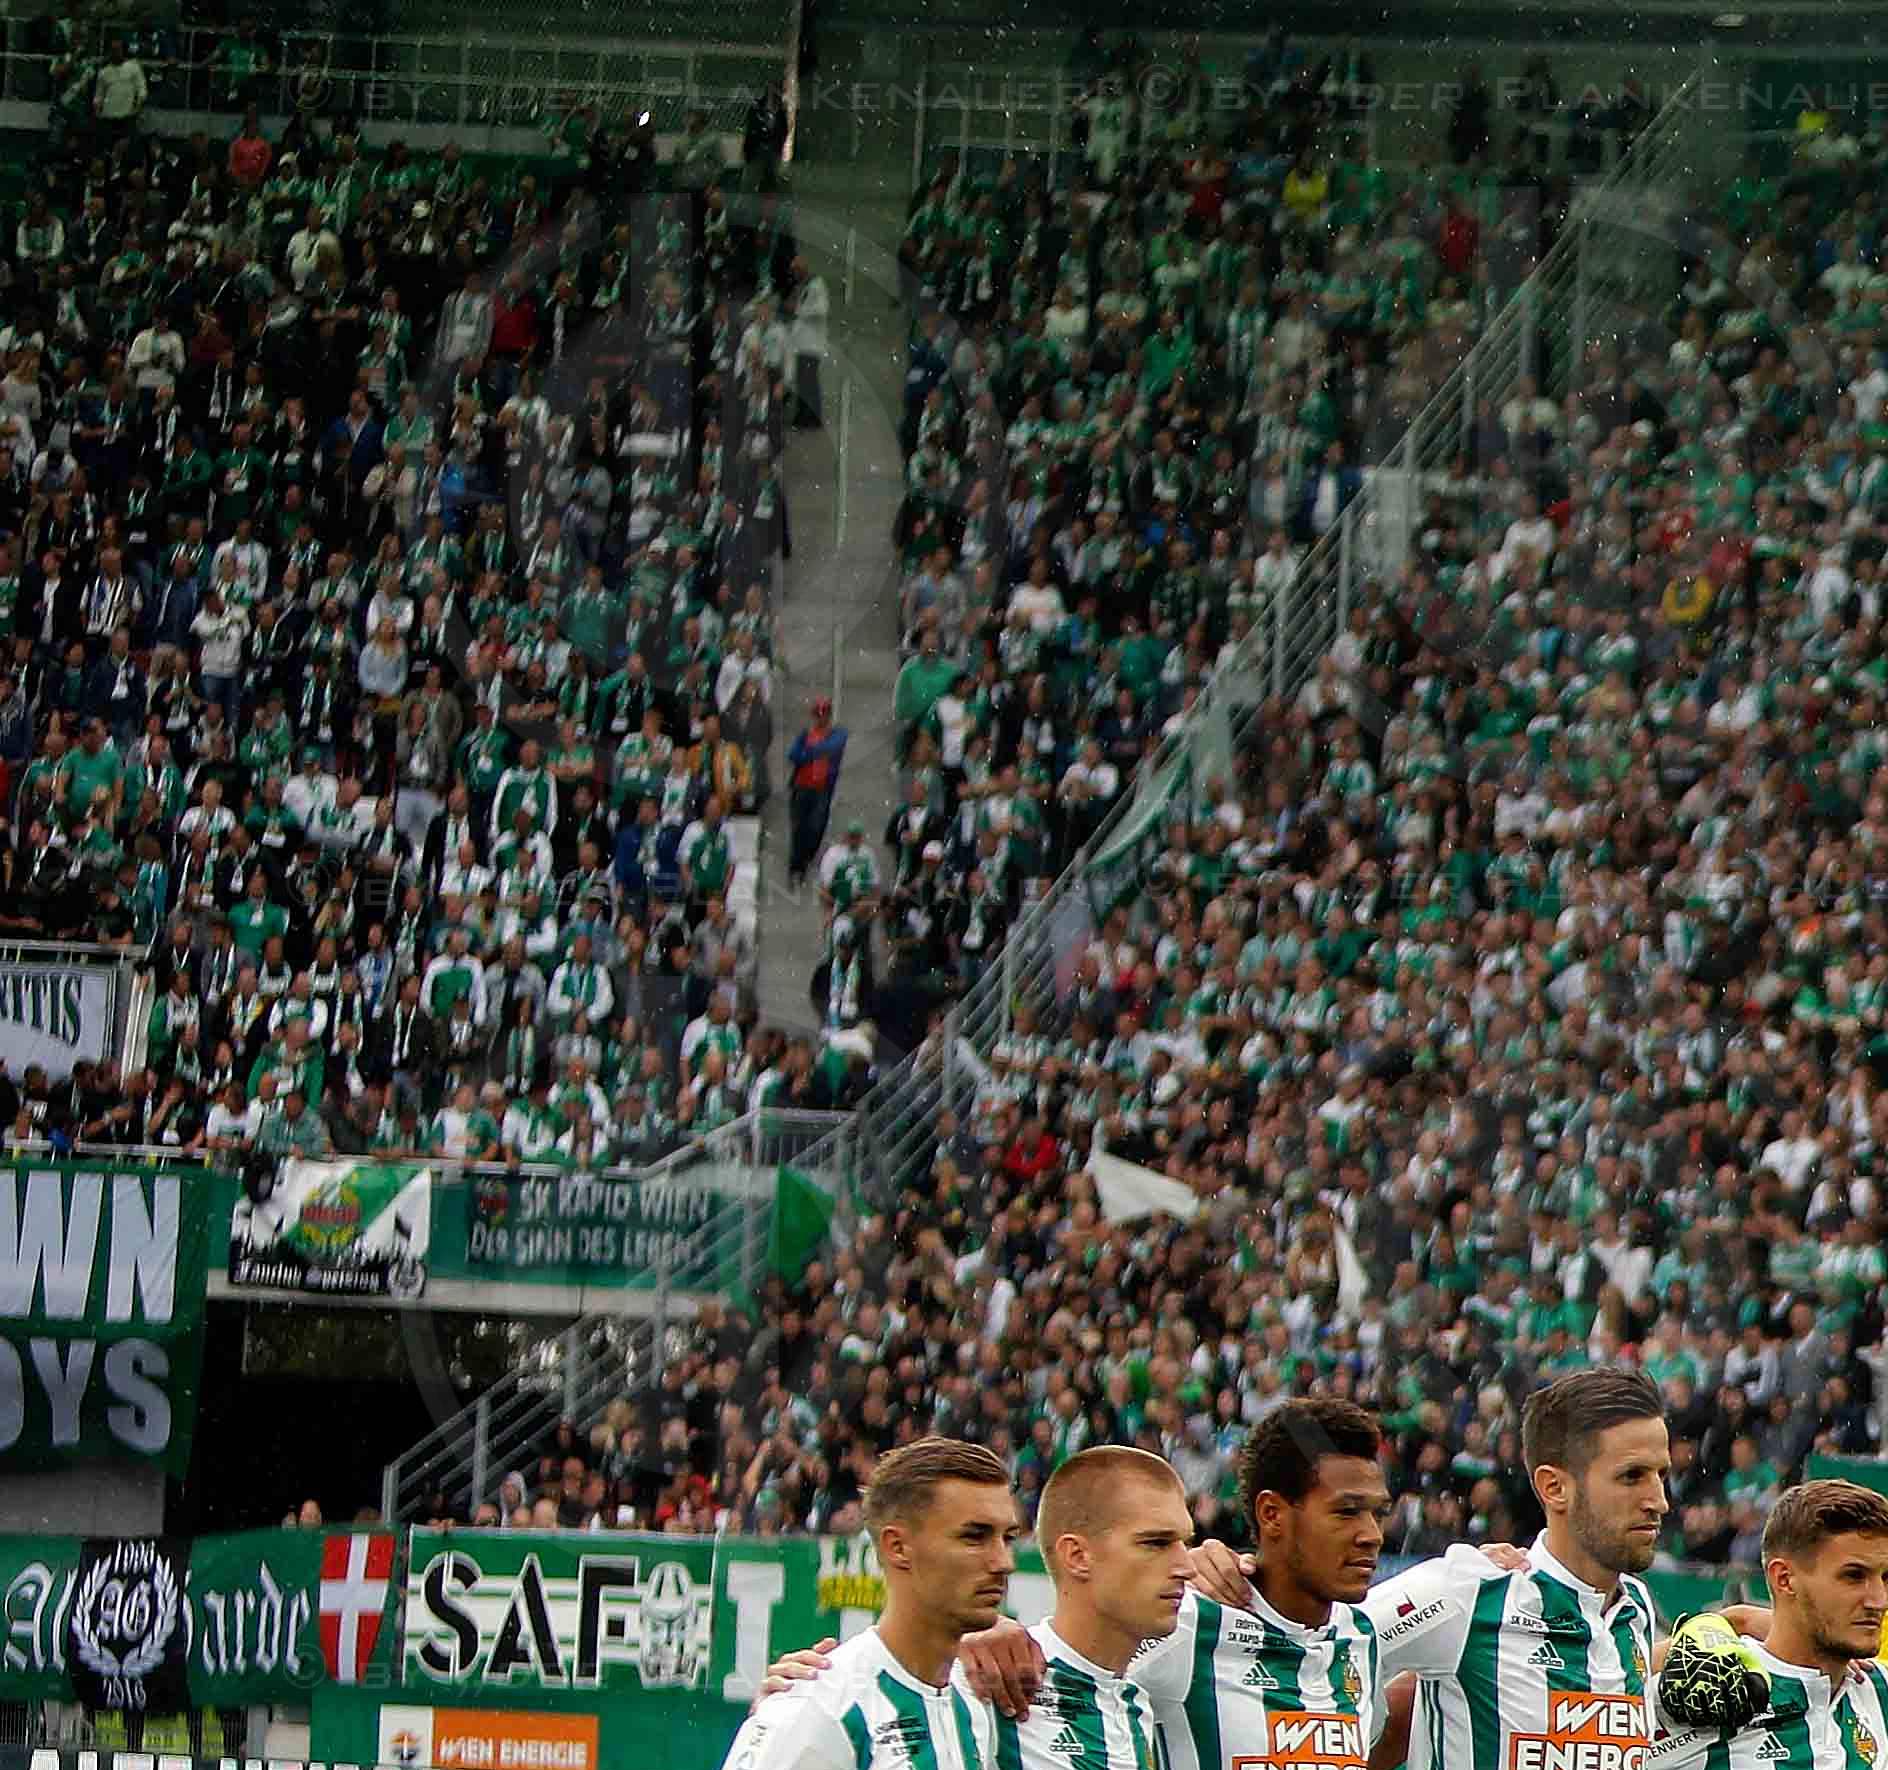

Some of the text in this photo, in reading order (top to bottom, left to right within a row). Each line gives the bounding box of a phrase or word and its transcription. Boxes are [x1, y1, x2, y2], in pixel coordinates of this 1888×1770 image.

[1379, 1599, 1446, 1643] WIENWERT
[1275, 1716, 1366, 1758] WIEN
[1555, 1696, 1649, 1738] WIEN
[499, 1738, 589, 1768] ENERGIE
